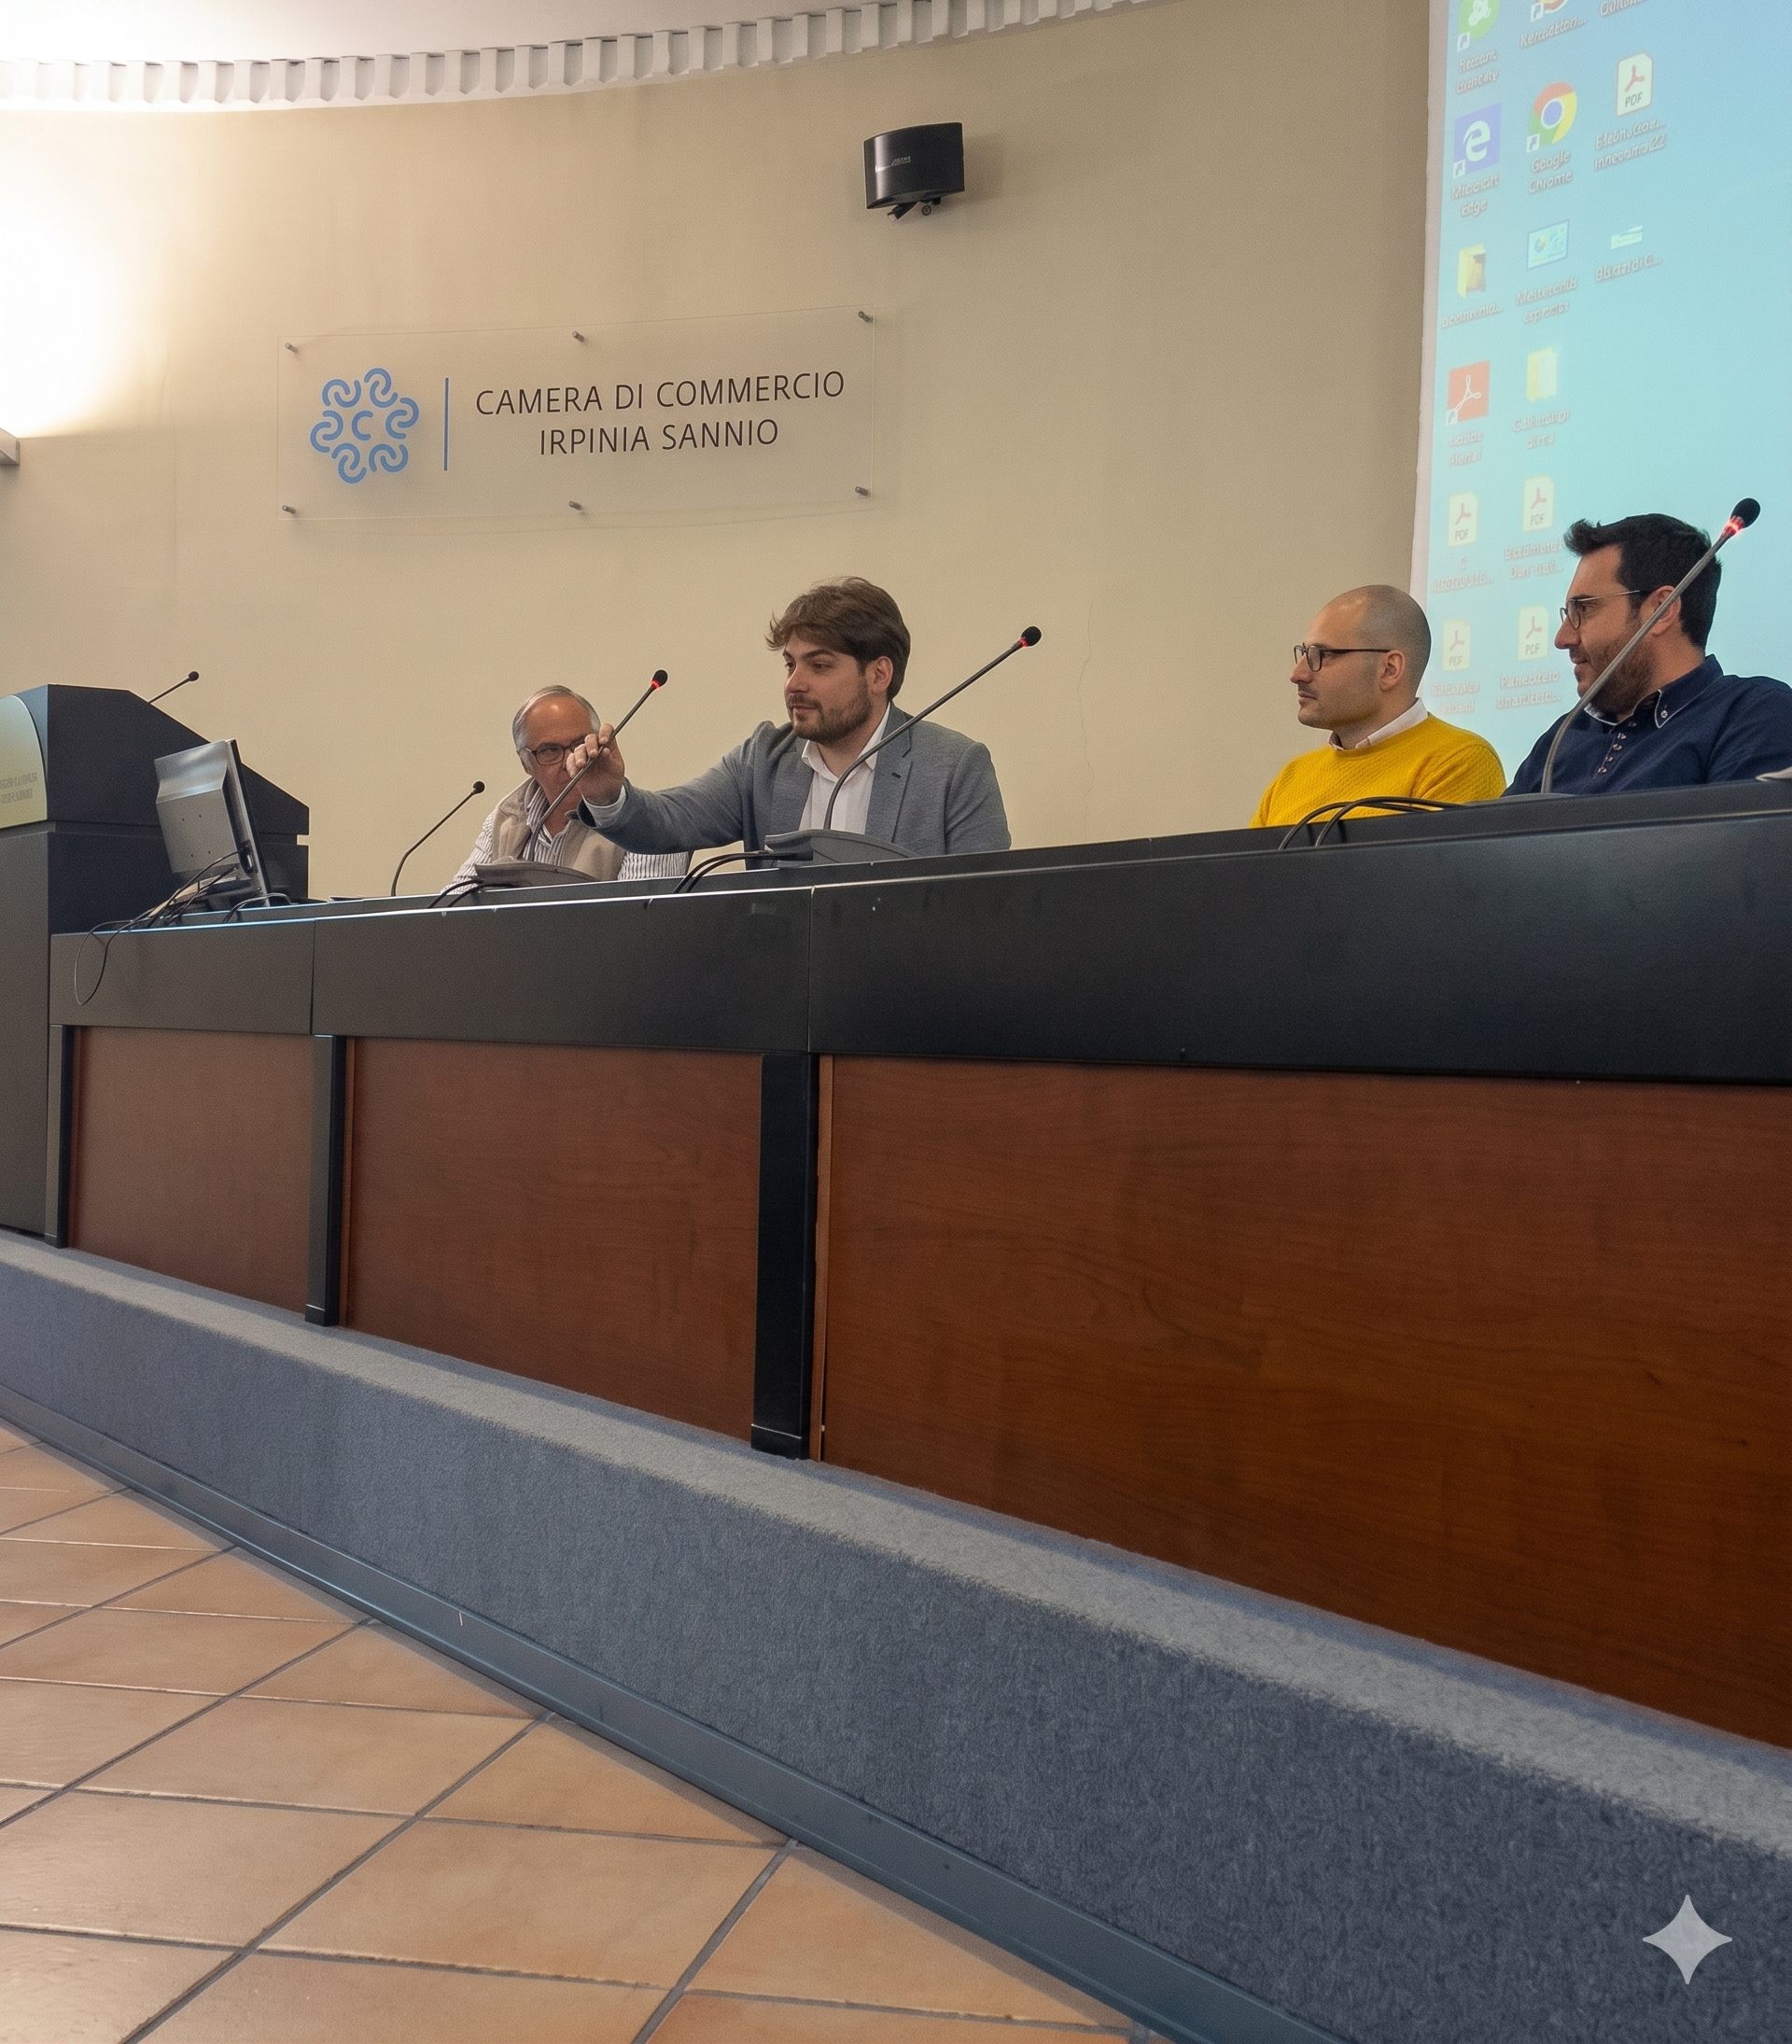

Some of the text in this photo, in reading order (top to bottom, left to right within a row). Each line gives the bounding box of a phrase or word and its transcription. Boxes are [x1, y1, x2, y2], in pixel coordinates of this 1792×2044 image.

[476, 371, 845, 415] CAMERA DI COMMERCIO
[540, 418, 778, 455] IRPINIA SANNIO
